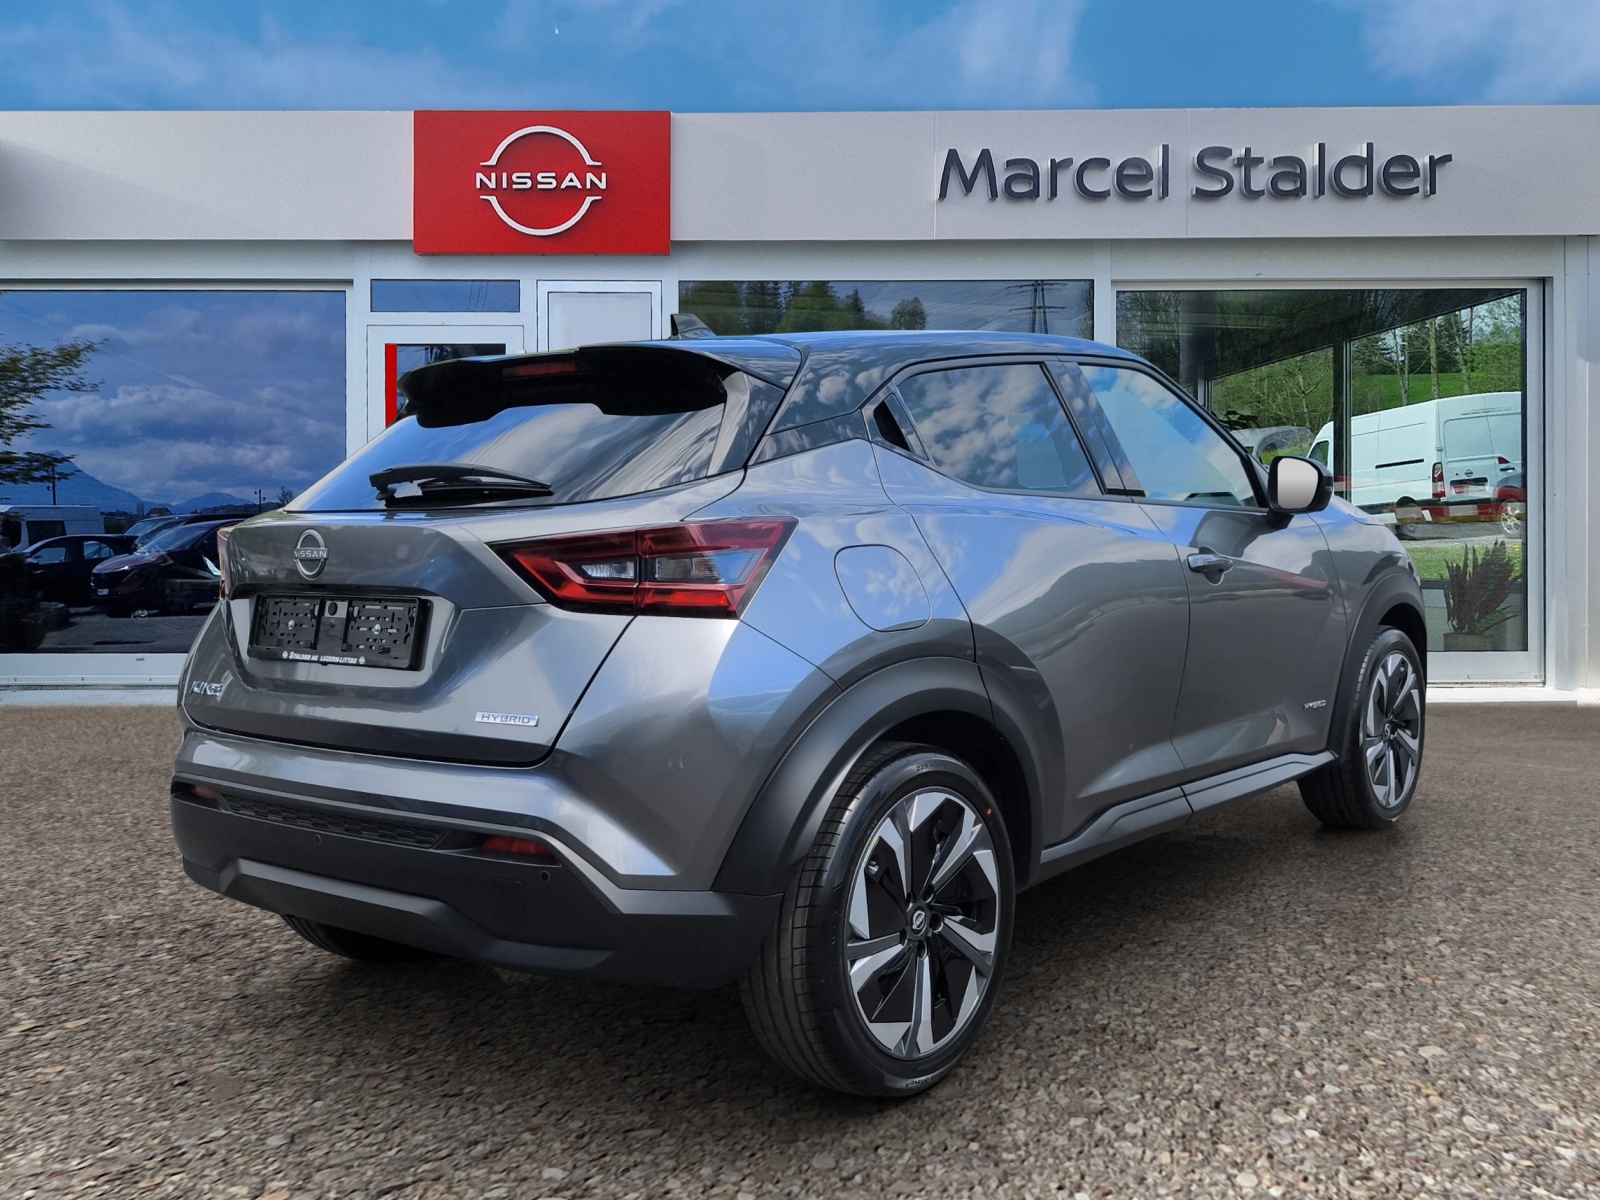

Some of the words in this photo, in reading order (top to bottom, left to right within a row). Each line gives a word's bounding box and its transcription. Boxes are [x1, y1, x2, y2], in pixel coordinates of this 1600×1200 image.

[937, 144, 1170, 201] Marcel
[1191, 142, 1453, 198] Stalder
[475, 172, 607, 189] NISSAN
[293, 550, 327, 558] NISSAN
[187, 681, 223, 696] JUKE
[480, 713, 531, 724] HYBRID
